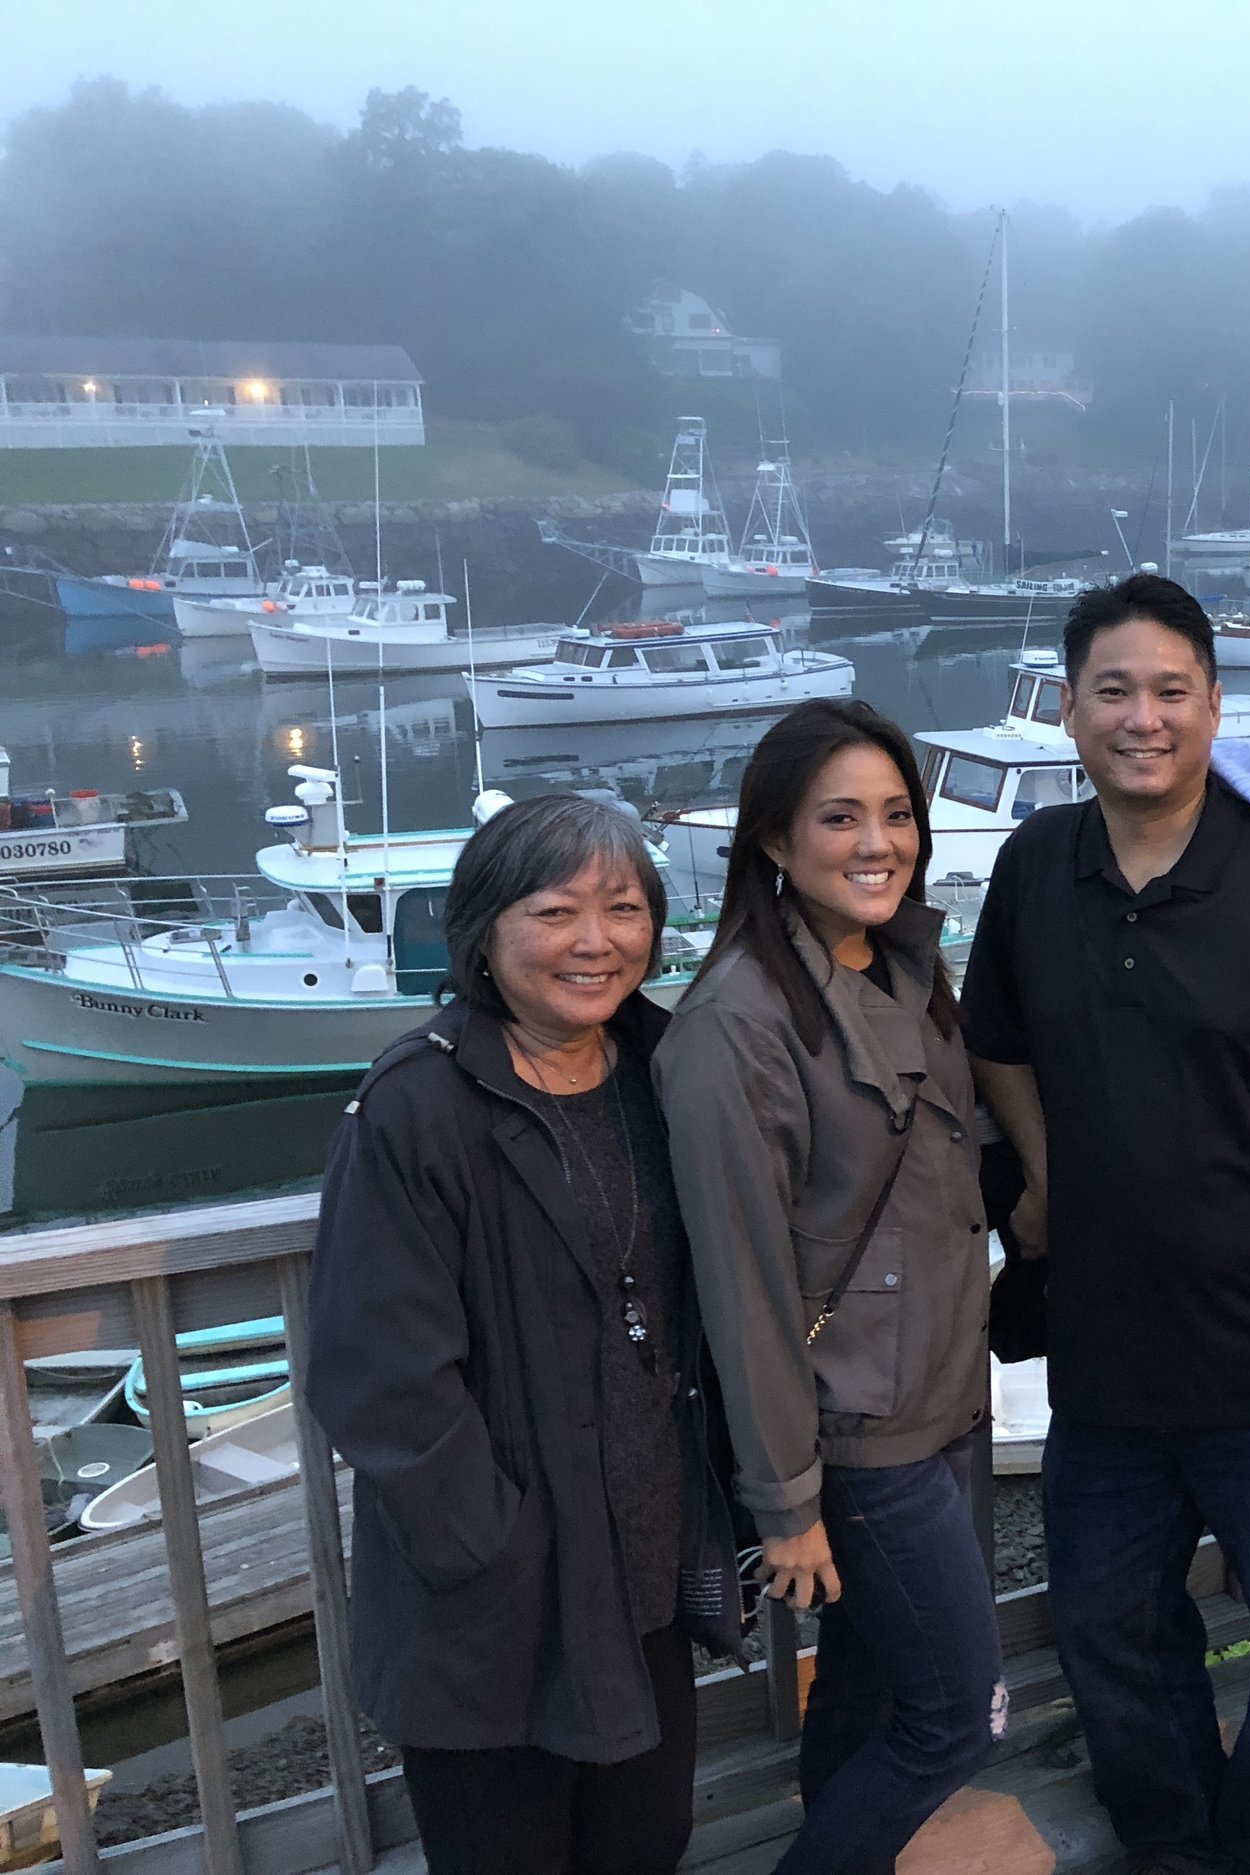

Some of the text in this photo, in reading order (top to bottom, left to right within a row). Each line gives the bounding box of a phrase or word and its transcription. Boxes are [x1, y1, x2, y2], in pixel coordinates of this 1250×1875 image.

[1016, 580, 1048, 592] SAILING
[72, 992, 206, 1021] Bunny Clark
